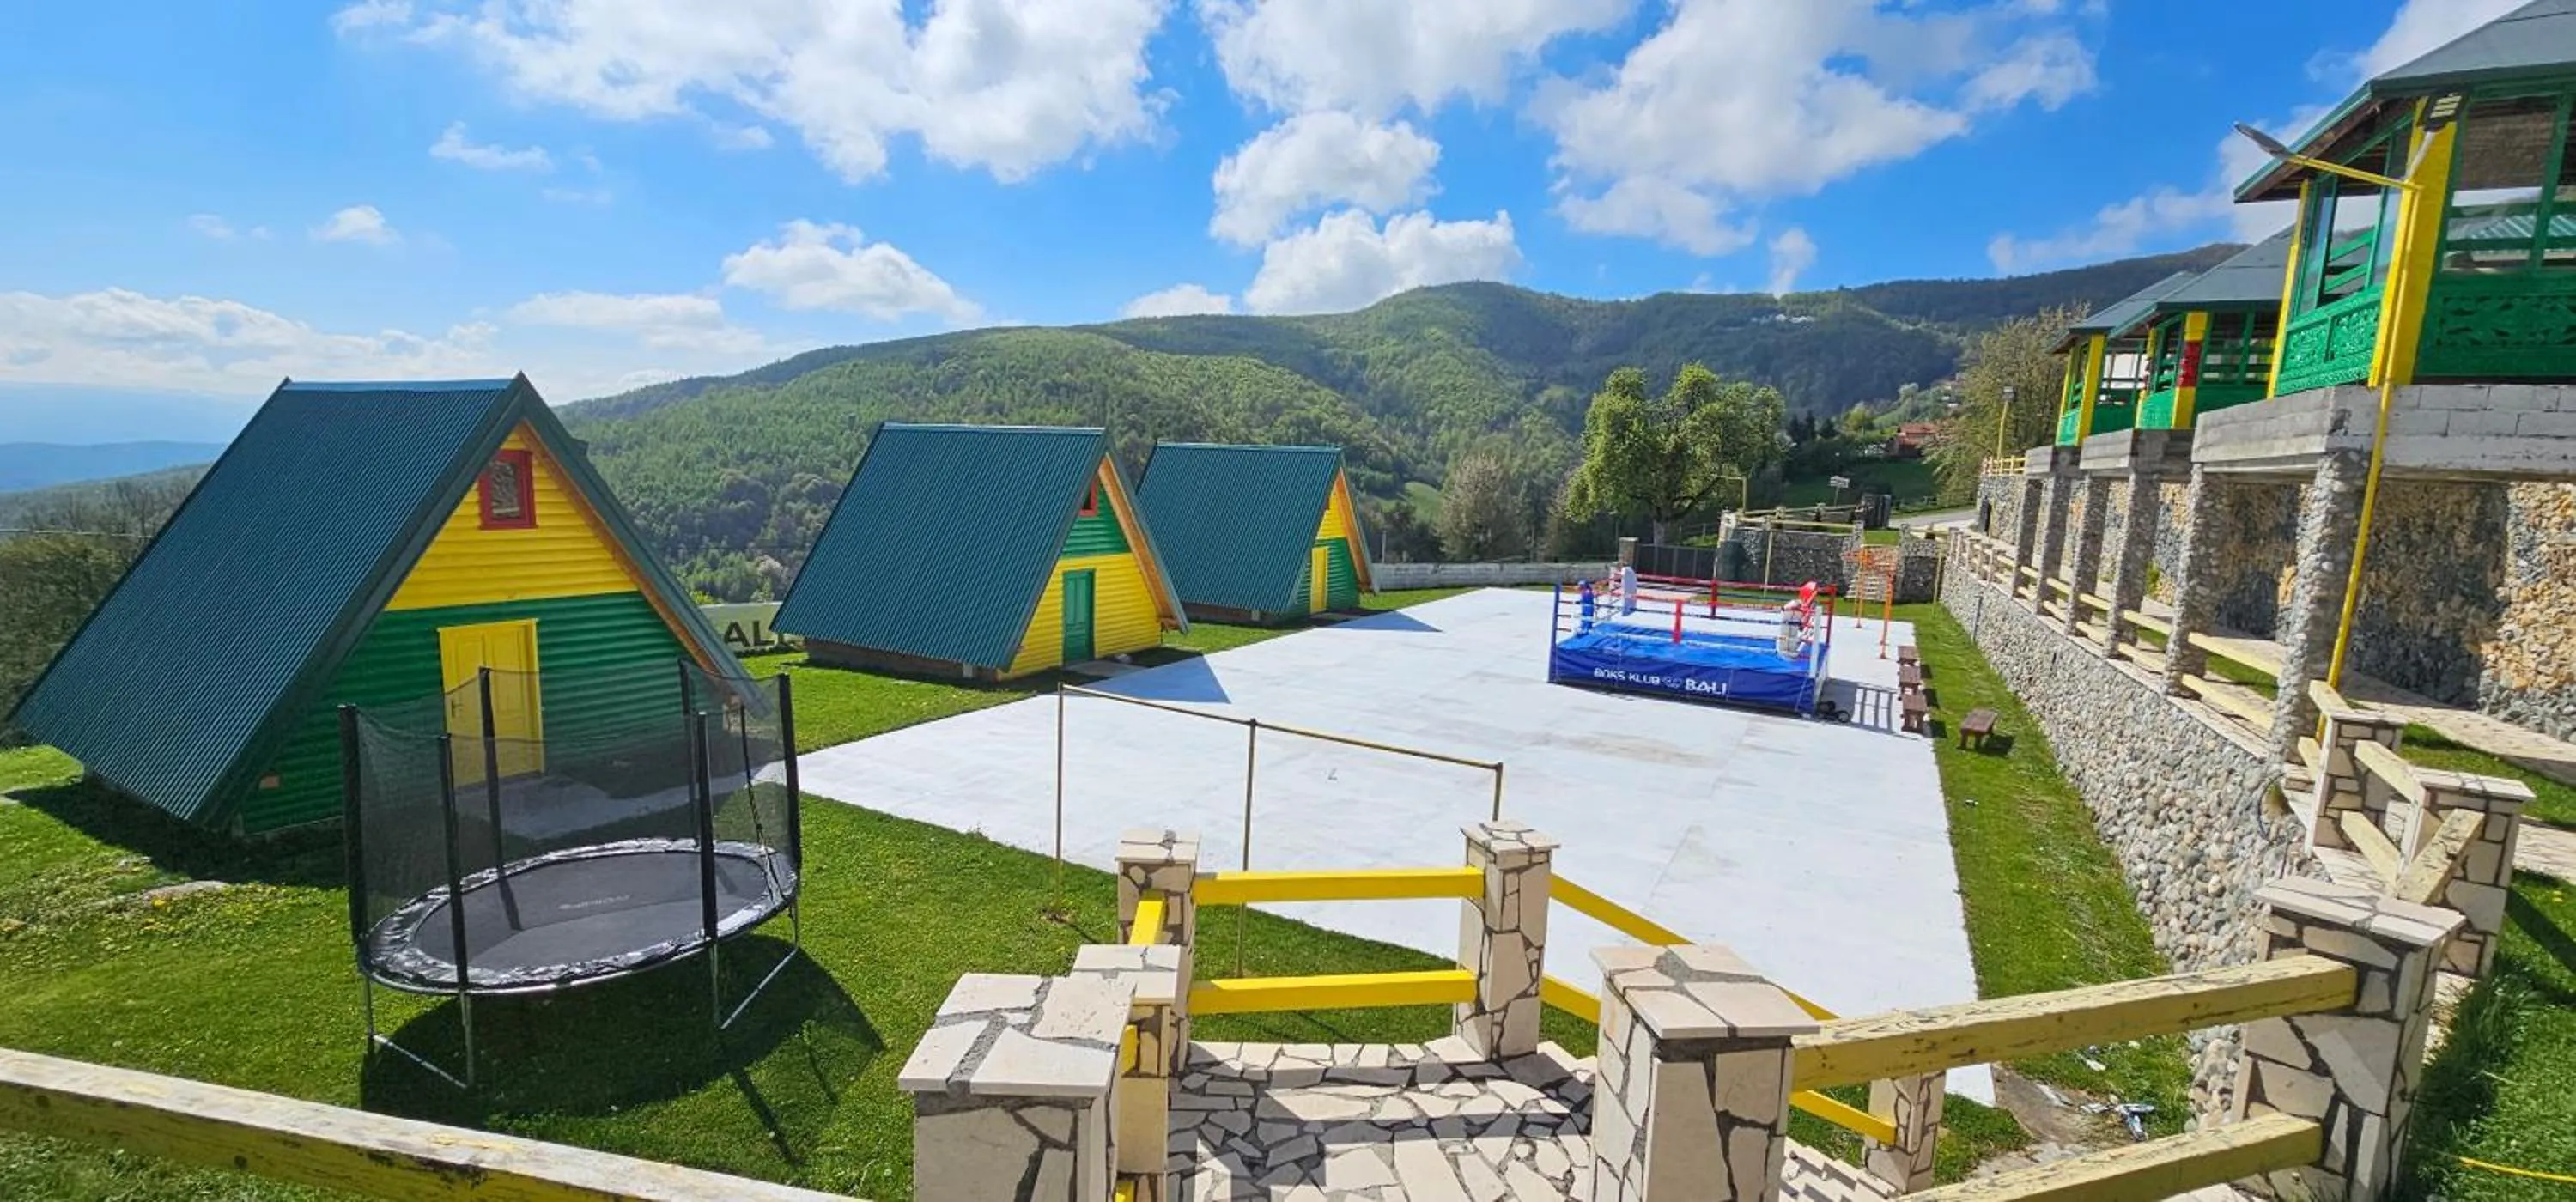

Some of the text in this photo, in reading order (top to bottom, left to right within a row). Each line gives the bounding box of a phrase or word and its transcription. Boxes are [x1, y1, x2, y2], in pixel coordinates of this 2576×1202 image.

[1594, 667, 1727, 695] BOKS KLUB BALI
